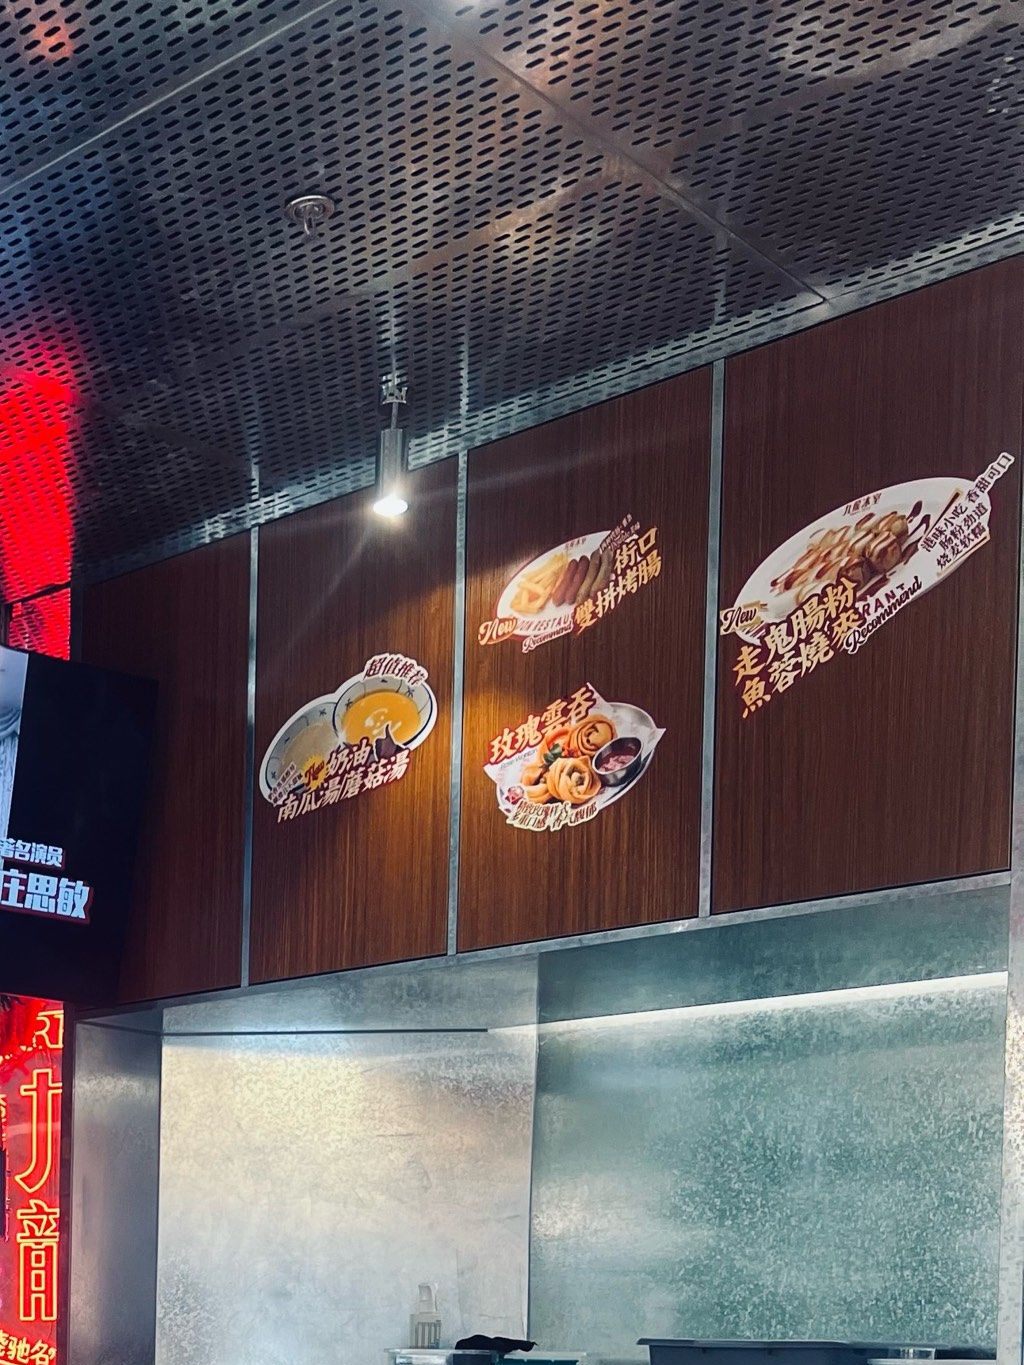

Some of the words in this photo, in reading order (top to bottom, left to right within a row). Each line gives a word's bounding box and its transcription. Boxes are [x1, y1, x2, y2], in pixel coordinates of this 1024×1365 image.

[920, 503, 968, 552] 港味小吃
[966, 453, 1012, 504] 香甜可口
[939, 502, 988, 550] 肠粉劲道
[614, 527, 658, 575] 街口
[575, 549, 663, 636] 雙拼烤腸
[844, 575, 922, 653] Recommend
[478, 616, 517, 646] New
[522, 624, 573, 653] Recommend
[722, 606, 758, 633] New
[732, 577, 857, 686] 走鬼腸粉
[364, 656, 426, 686] 超值推荐
[489, 687, 596, 763] 玫瑰雲吞
[326, 739, 372, 778] 奶油
[0, 838, 63, 868] 著名演员
